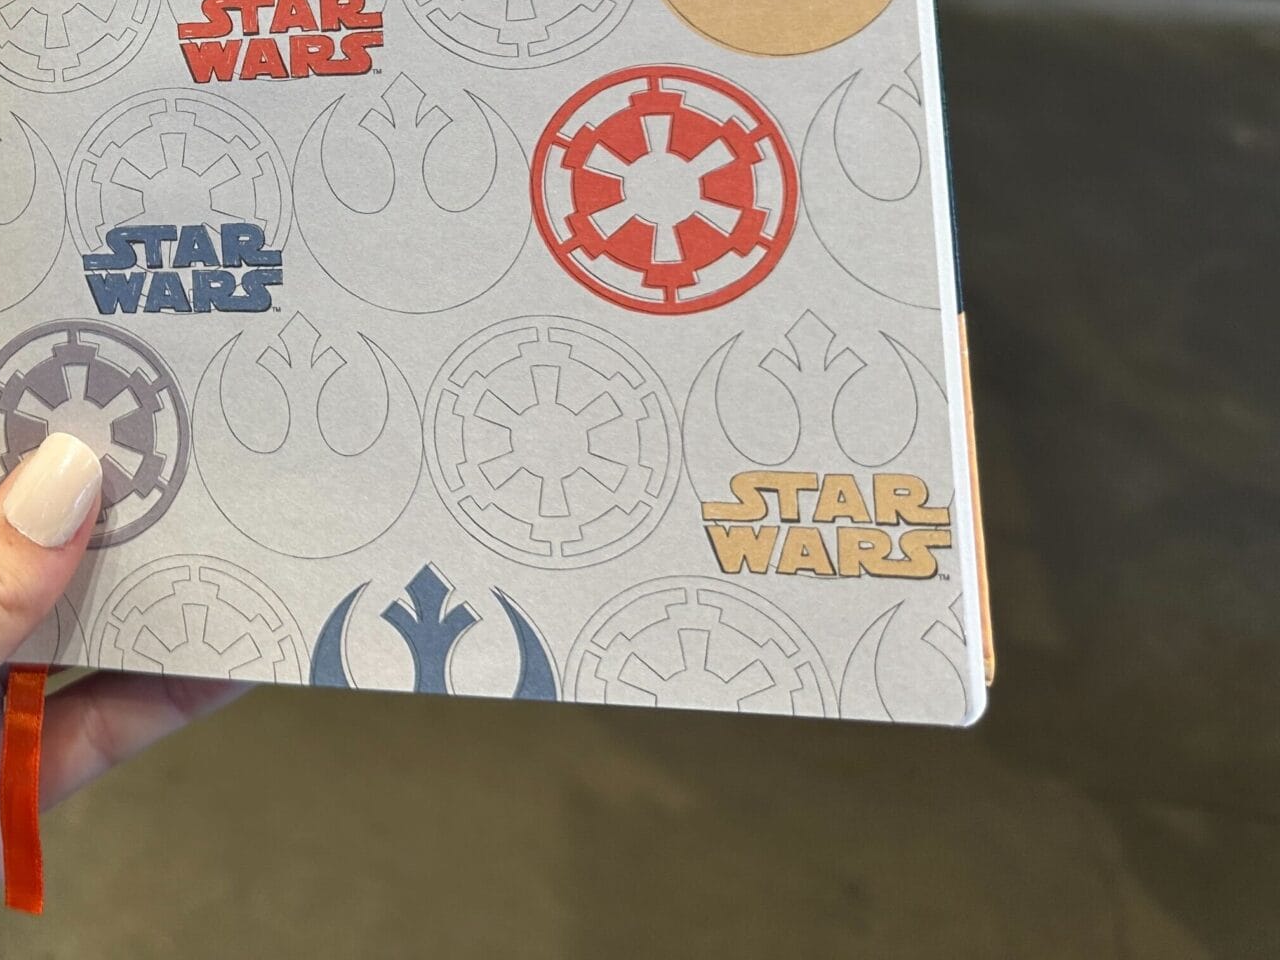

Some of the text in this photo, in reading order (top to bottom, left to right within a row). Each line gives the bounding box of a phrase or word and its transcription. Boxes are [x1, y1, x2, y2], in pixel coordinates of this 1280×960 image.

[180, 31, 384, 84] WARS
[82, 223, 282, 271] STAR
[85, 268, 283, 314] WARS
[701, 470, 951, 526] STAR
[704, 524, 952, 580] WARS
